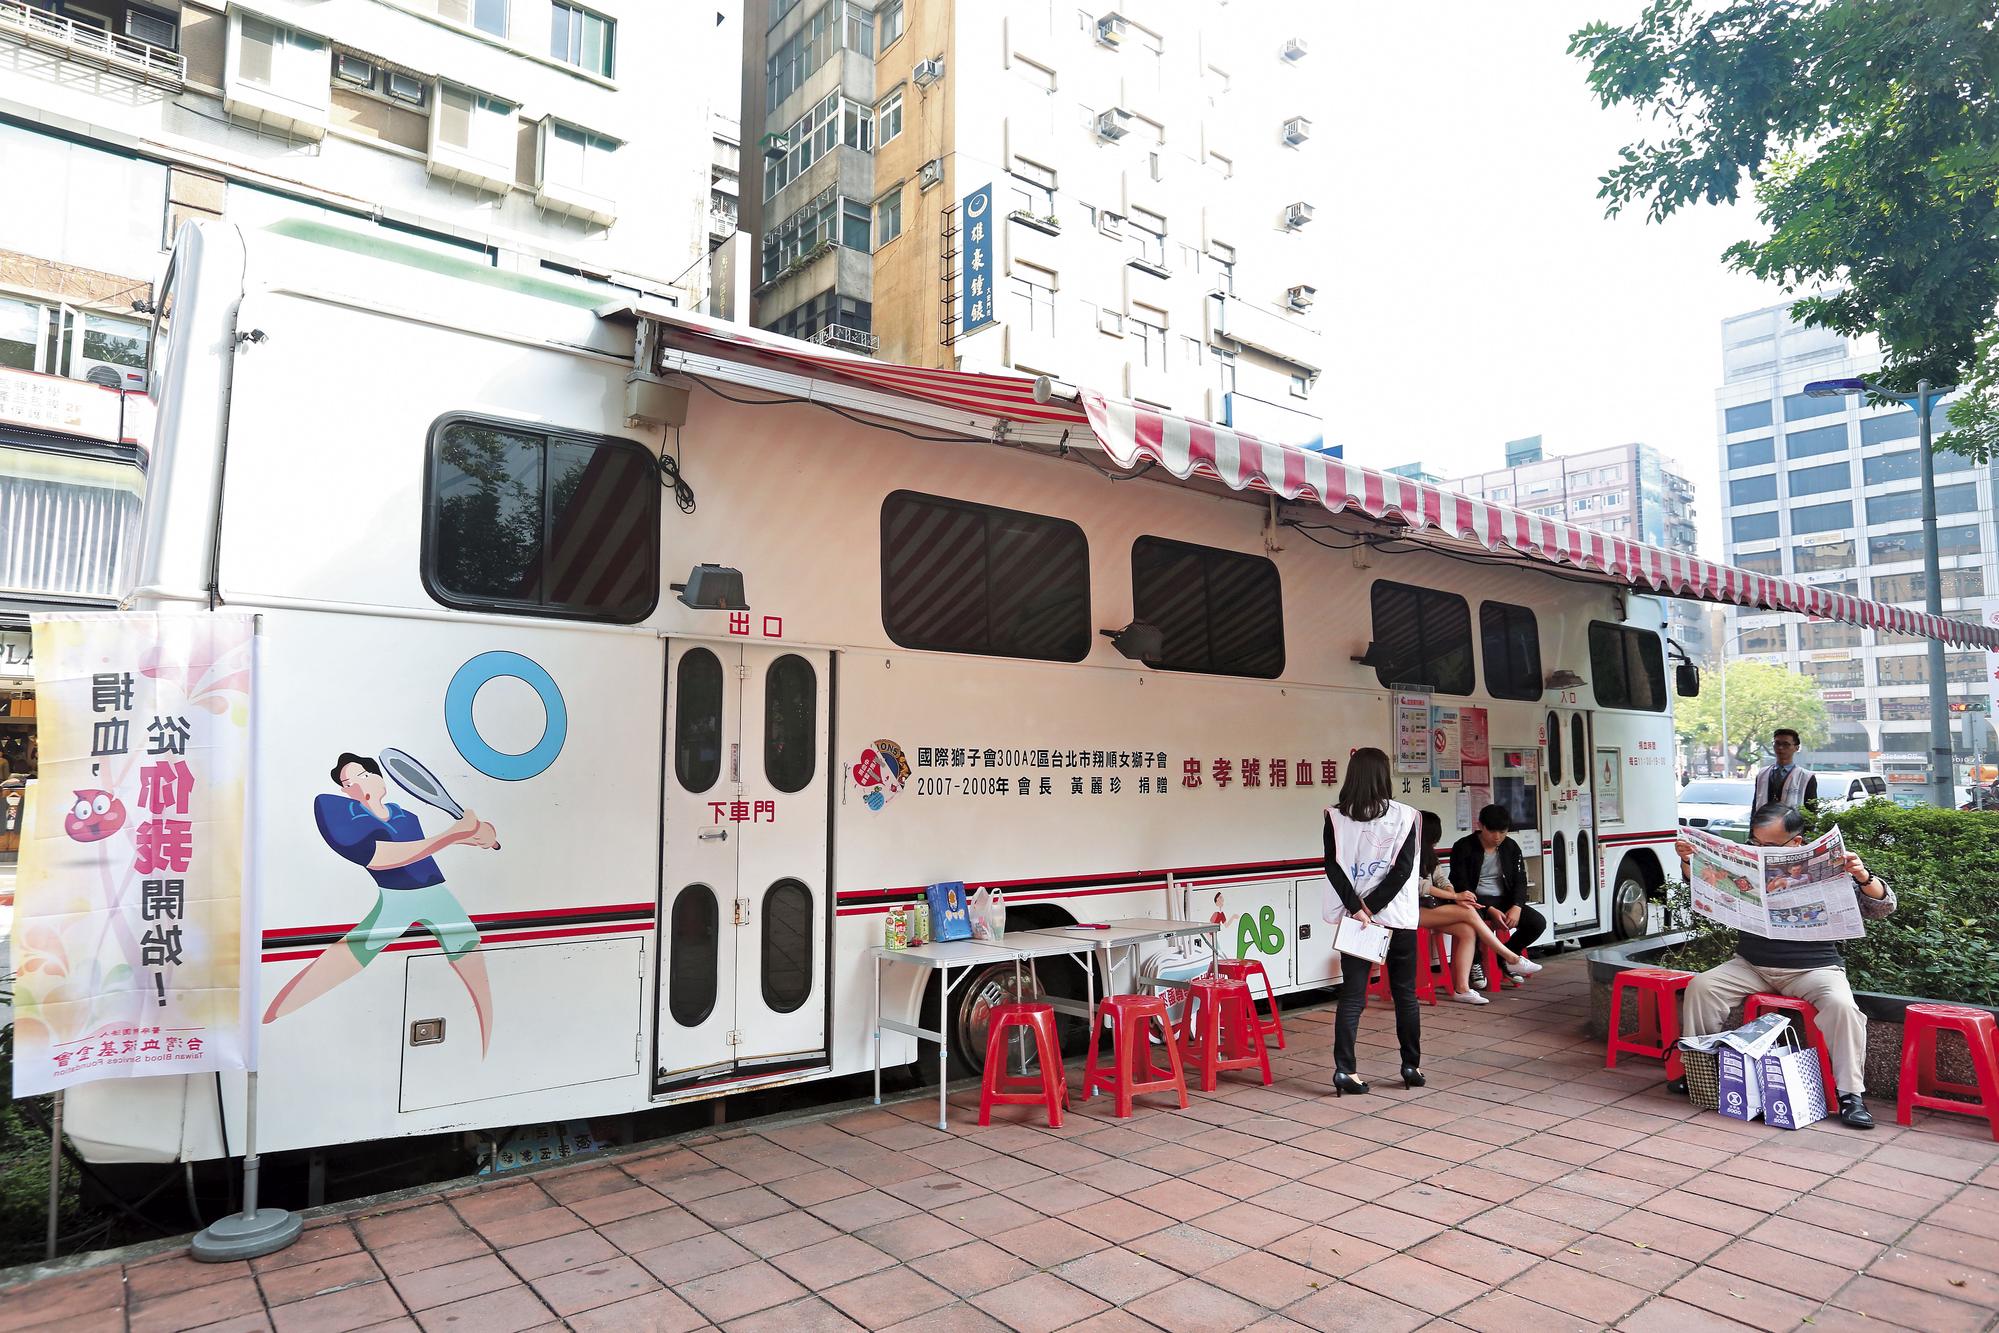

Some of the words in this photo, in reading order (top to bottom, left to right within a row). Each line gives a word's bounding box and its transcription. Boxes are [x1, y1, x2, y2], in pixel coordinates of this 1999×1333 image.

[729, 611, 783, 638] 出口
[1561, 691, 1577, 704] 入口
[1182, 757, 1338, 788] 忠孝號捐血車
[707, 800, 775, 824] 下車門
[1236, 905, 1286, 960] AB
